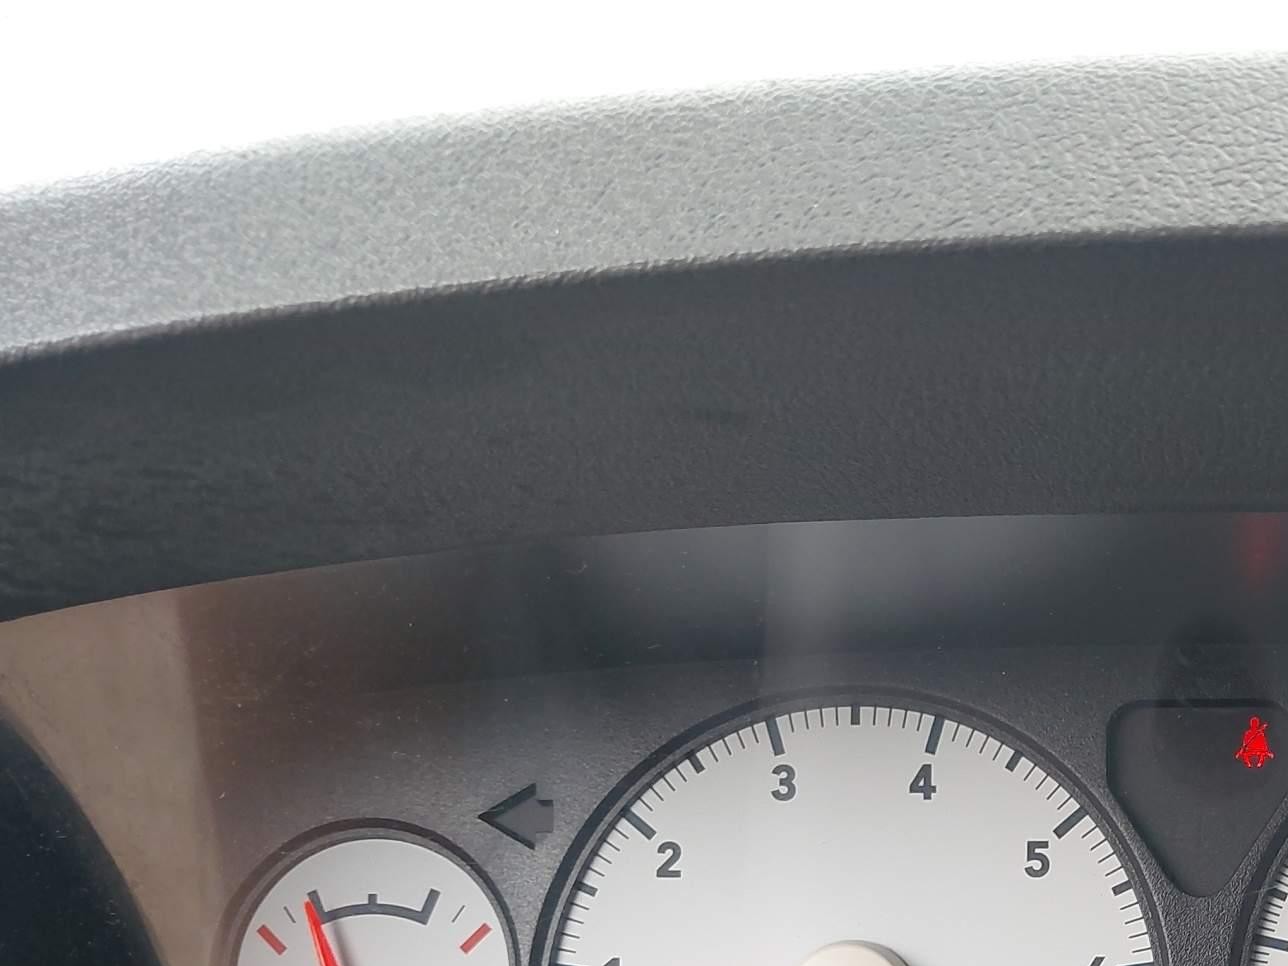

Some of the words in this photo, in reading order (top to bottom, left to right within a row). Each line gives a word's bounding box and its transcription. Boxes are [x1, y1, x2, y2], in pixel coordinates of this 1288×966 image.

[771, 764, 796, 801] 3
[910, 764, 936, 800] 4
[656, 841, 681, 878] 2
[1025, 841, 1049, 877] 5
